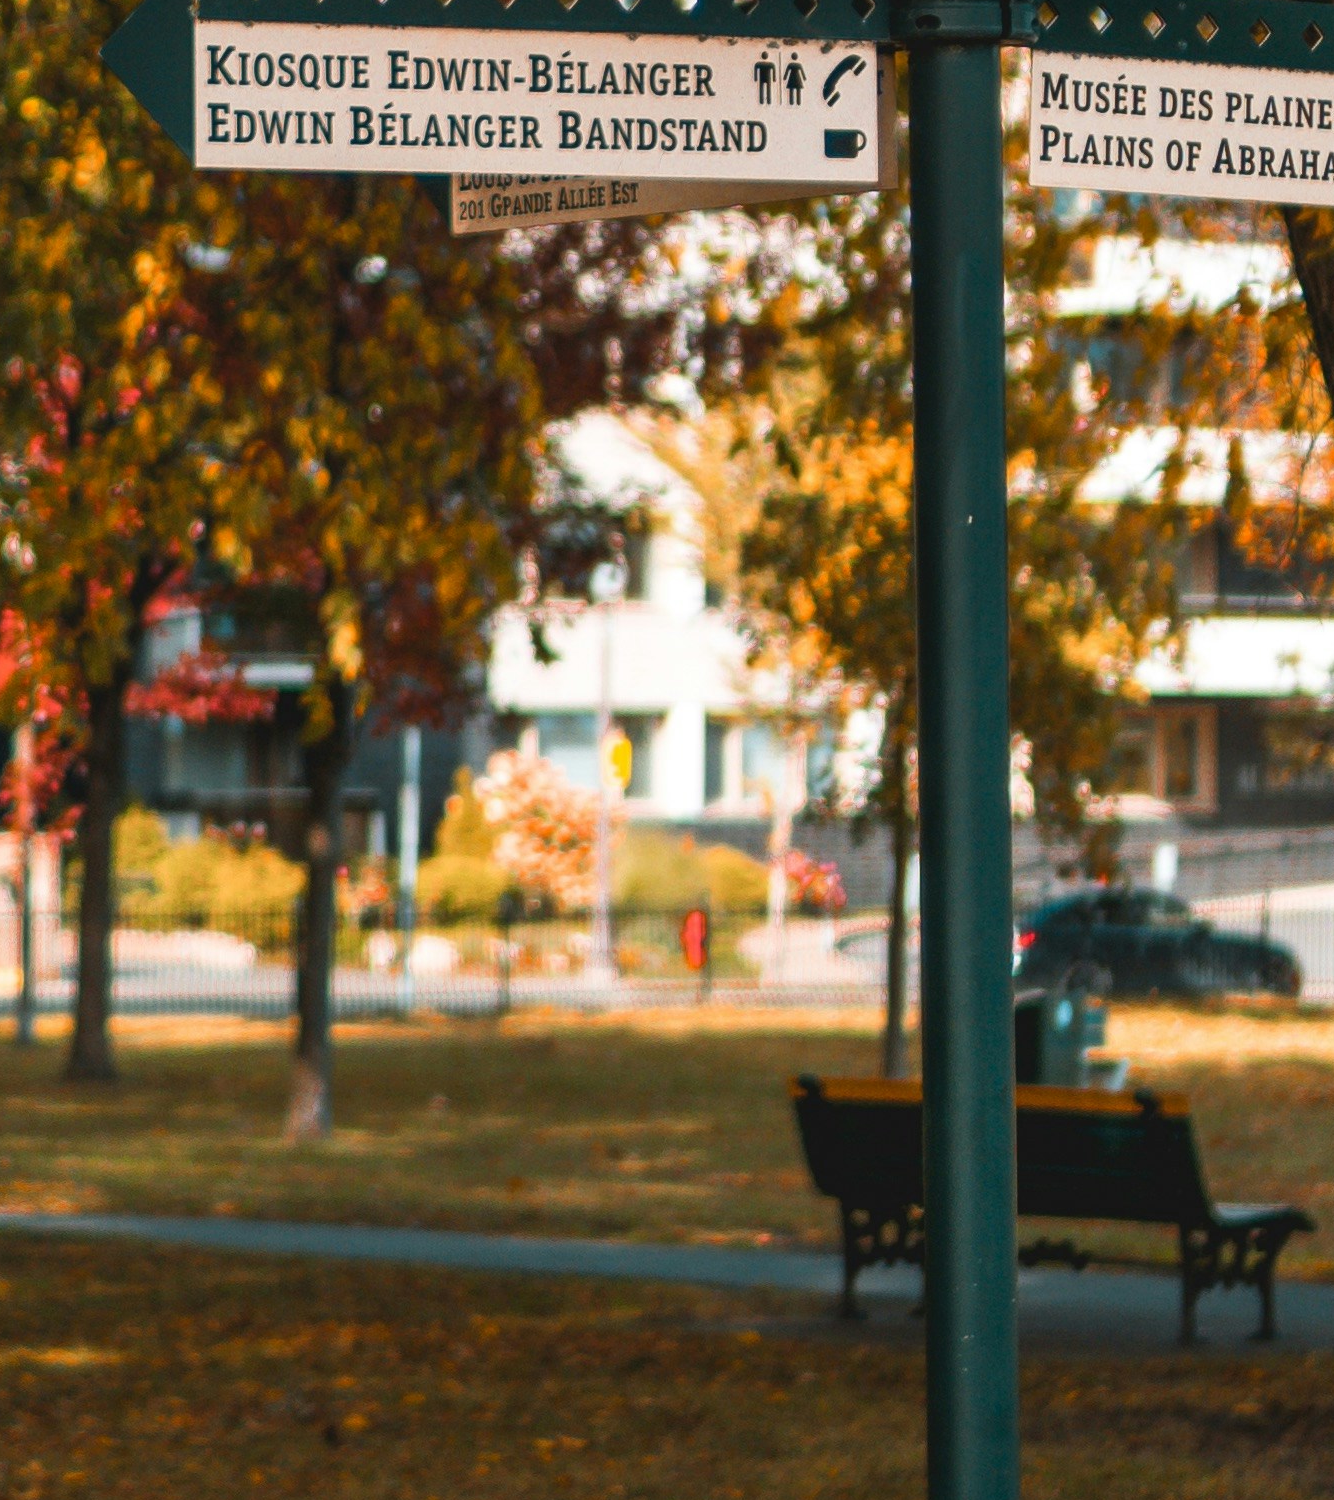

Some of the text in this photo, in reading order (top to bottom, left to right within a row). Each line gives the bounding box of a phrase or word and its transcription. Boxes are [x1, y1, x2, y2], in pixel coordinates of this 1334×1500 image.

[207, 44, 716, 97] KIOSQUE EDWIN-BÉLANGER
[1040, 71, 1147, 116] MUSÉE
[1159, 86, 1213, 121] DES
[207, 102, 768, 153] EDWIN BÉLANGER BANDSTAND
[1040, 124, 1154, 169] PLAINS
[1166, 139, 1202, 171] OF
[459, 199, 486, 221] 201
[610, 180, 639, 206] EST
